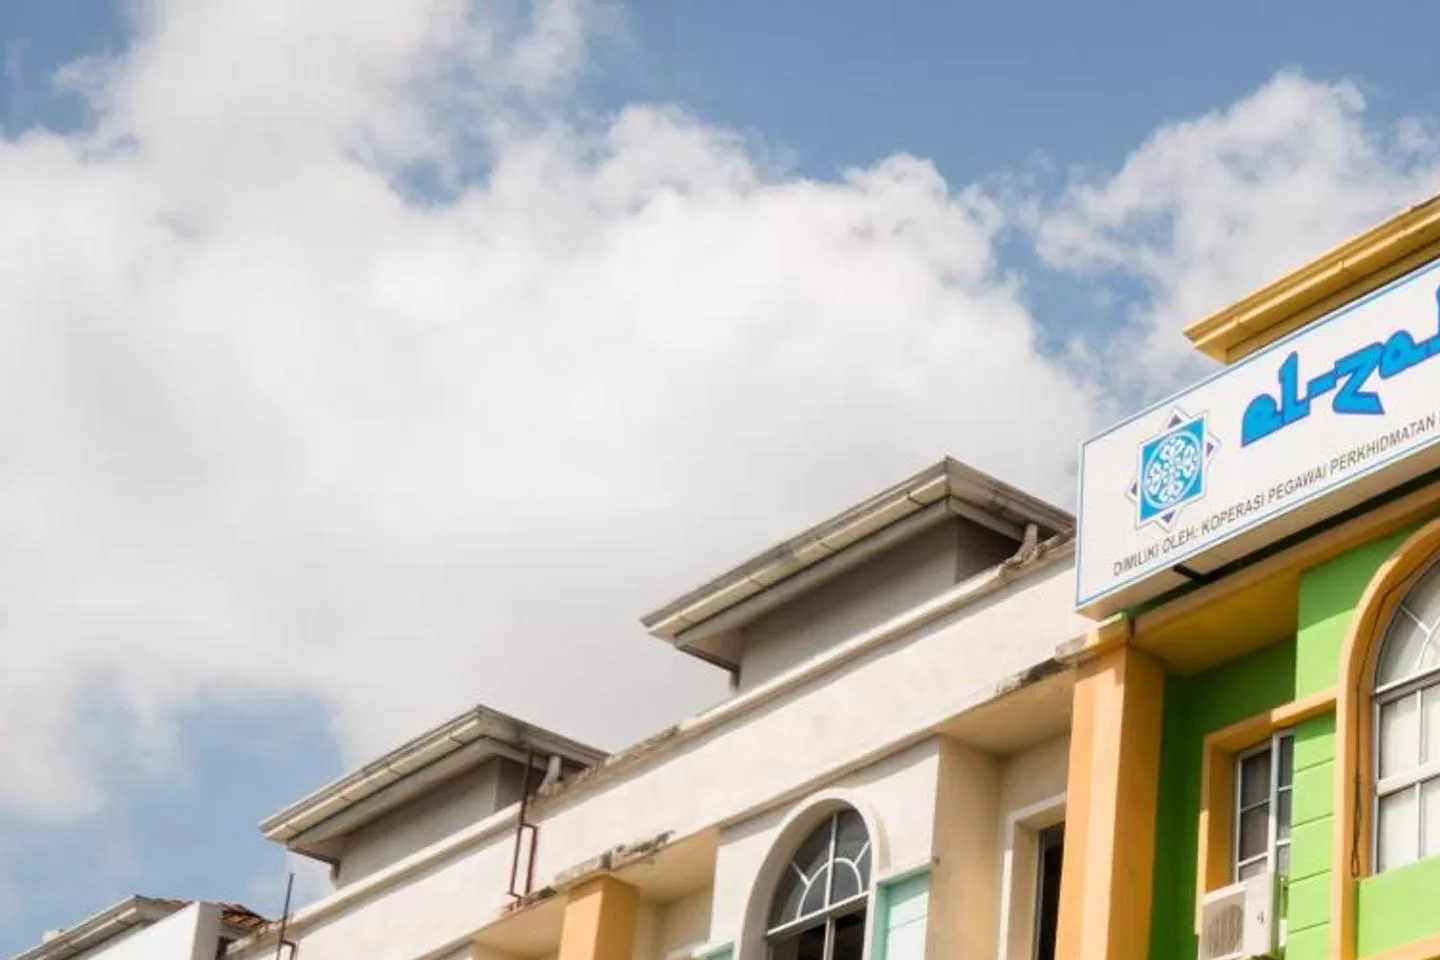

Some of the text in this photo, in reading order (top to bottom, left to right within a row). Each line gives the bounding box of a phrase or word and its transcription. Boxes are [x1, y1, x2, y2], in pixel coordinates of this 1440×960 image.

[1113, 542, 1163, 577] DIMILIKI
[1201, 498, 1266, 533] KOPERASI
[1267, 464, 1327, 507] PEGAWAI
[1329, 412, 1436, 480] PERKHIDMATAN
